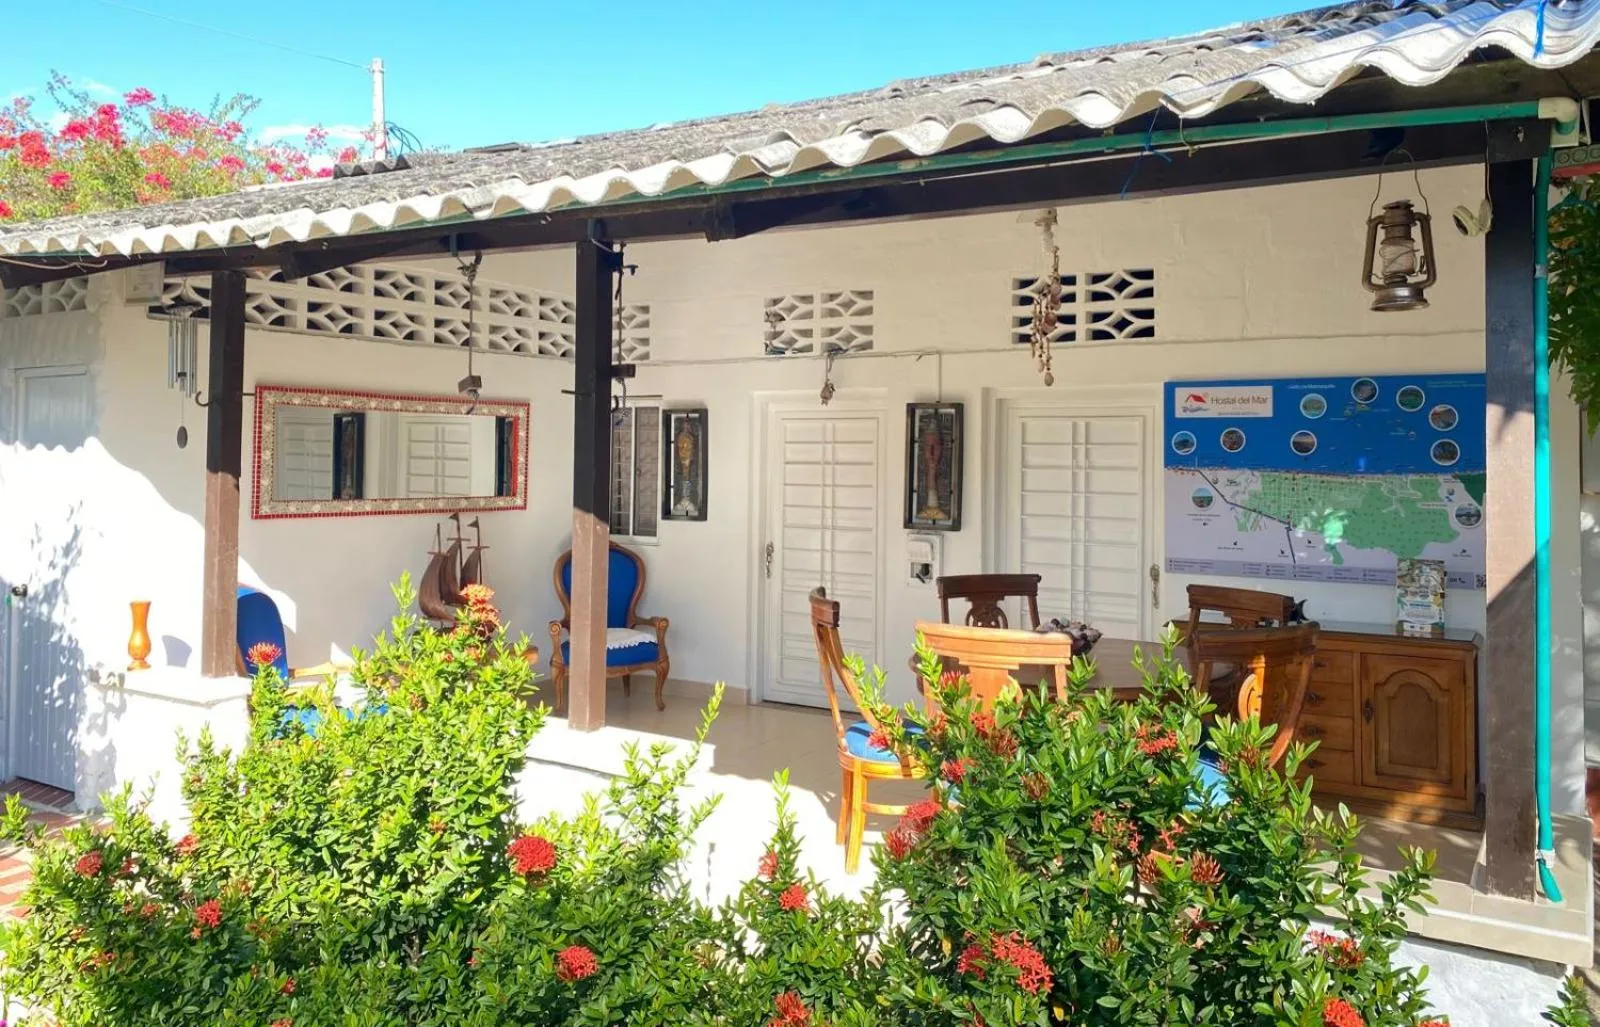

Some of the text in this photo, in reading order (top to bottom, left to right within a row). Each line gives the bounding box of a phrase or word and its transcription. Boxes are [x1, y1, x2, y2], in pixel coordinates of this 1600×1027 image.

[1210, 394, 1268, 405] Hostal del Mar
